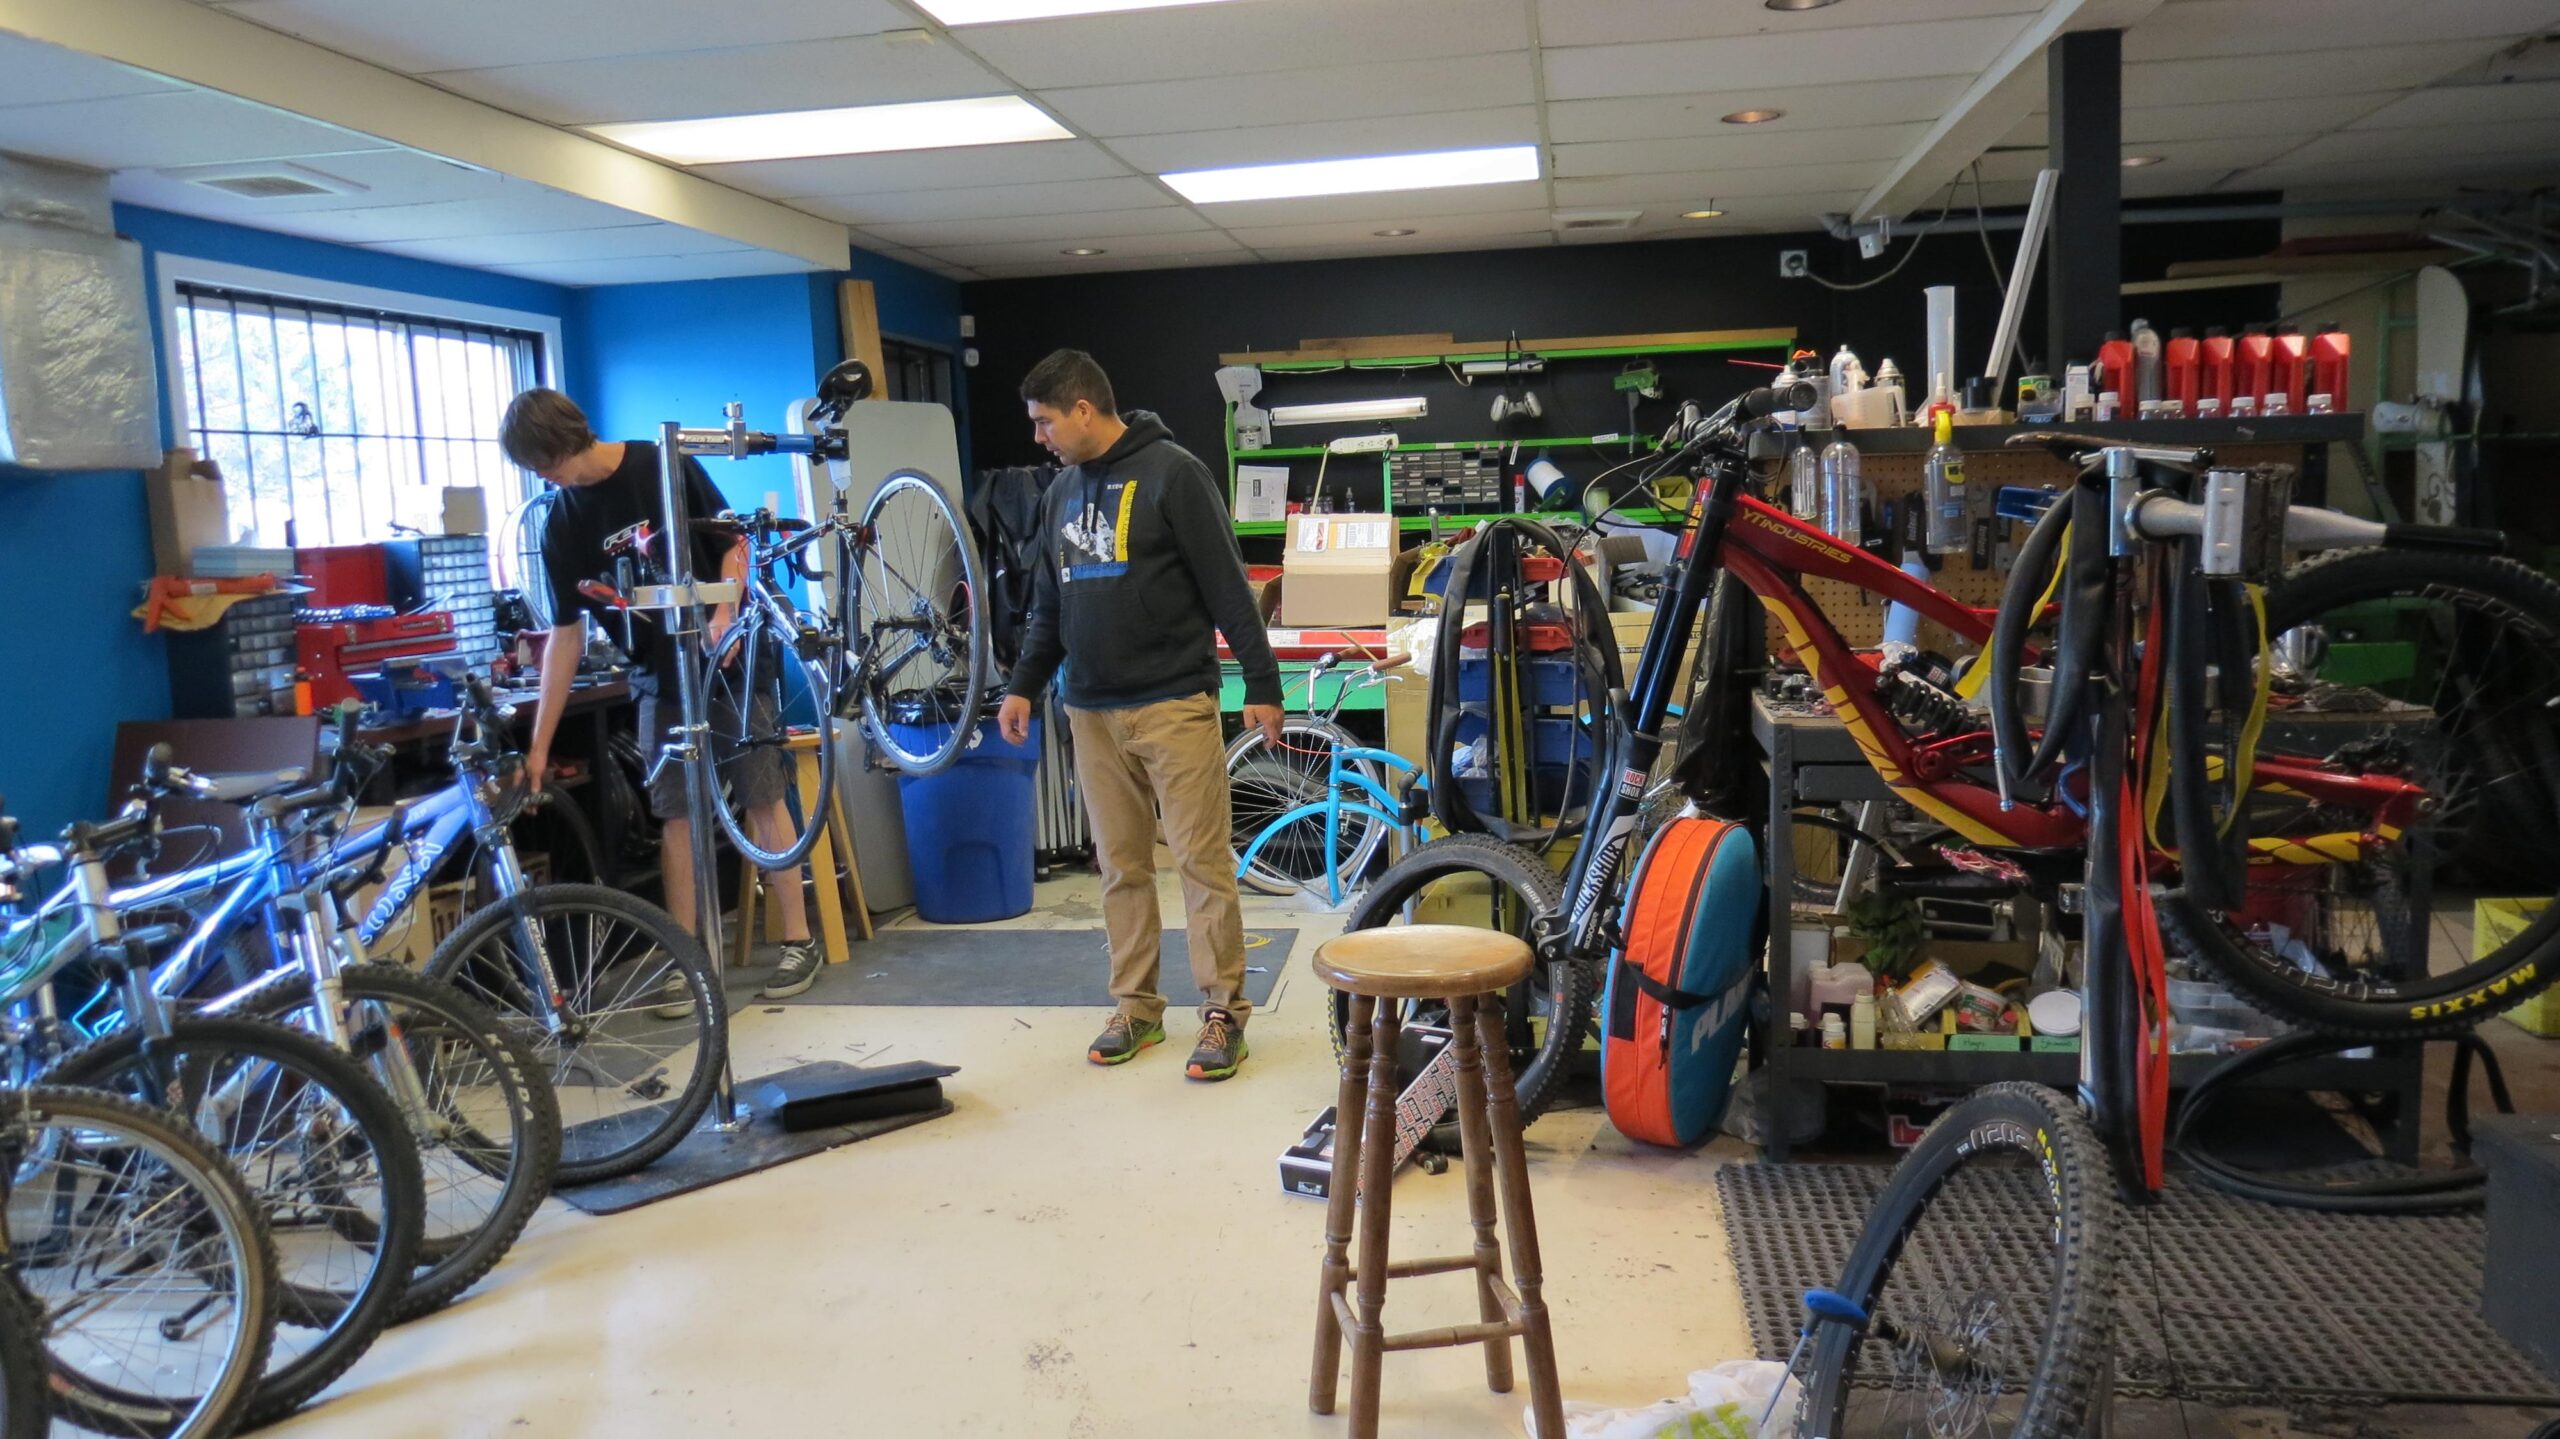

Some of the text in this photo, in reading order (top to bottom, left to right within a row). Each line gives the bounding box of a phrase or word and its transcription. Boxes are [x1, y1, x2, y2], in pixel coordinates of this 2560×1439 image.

[1620, 783, 1641, 798] SHOX
[1624, 770, 1646, 786] ROCK
[2410, 962, 2536, 1019] MAXXIS
[484, 1033, 534, 1121] KENDA
